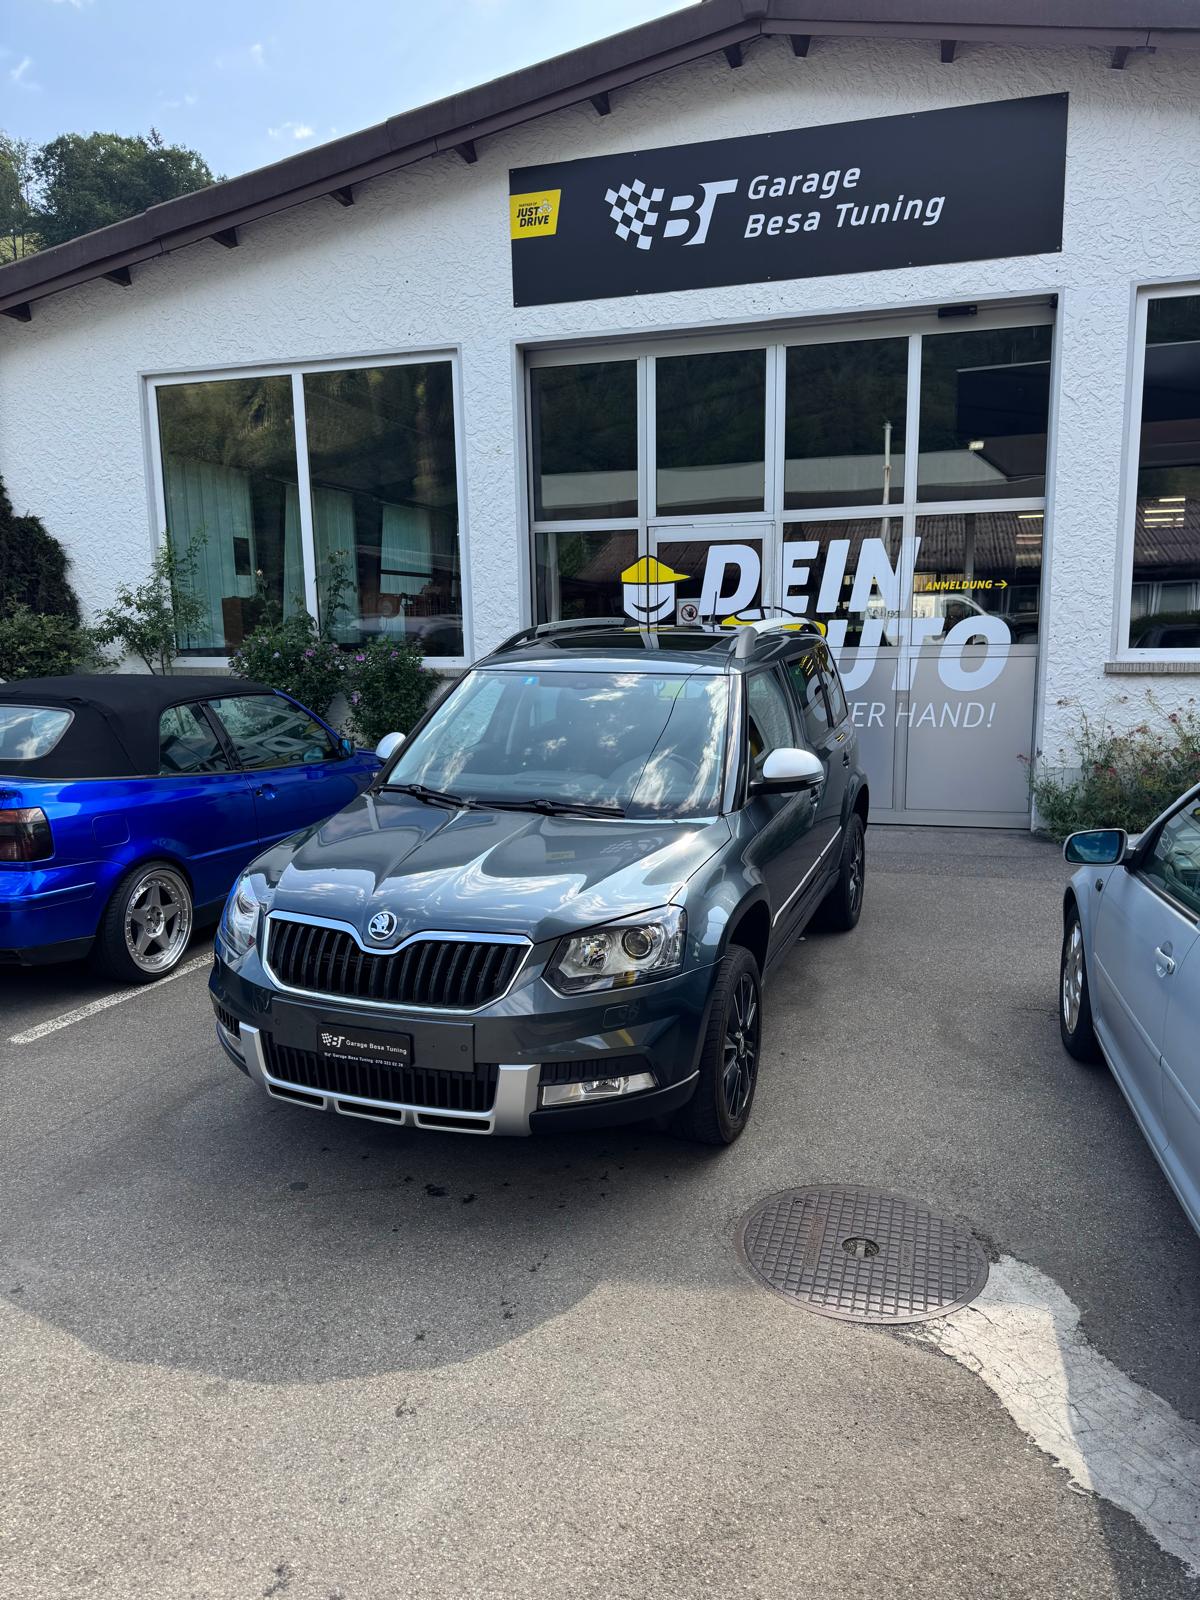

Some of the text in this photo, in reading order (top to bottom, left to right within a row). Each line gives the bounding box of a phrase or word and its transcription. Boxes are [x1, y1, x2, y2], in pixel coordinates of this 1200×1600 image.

[748, 166, 862, 201] Garage
[517, 206, 540, 218] JUST
[520, 215, 550, 228] DRIVE
[743, 195, 946, 239] Besa Tuning
[699, 536, 921, 616] DEIN
[925, 580, 993, 590] ANMELDUNG
[825, 614, 1012, 692] UTO
[847, 702, 996, 728] ER HAND!
[346, 1040, 368, 1049] Garage
[369, 1043, 384, 1051] Besa
[386, 1045, 407, 1055] Tuning
